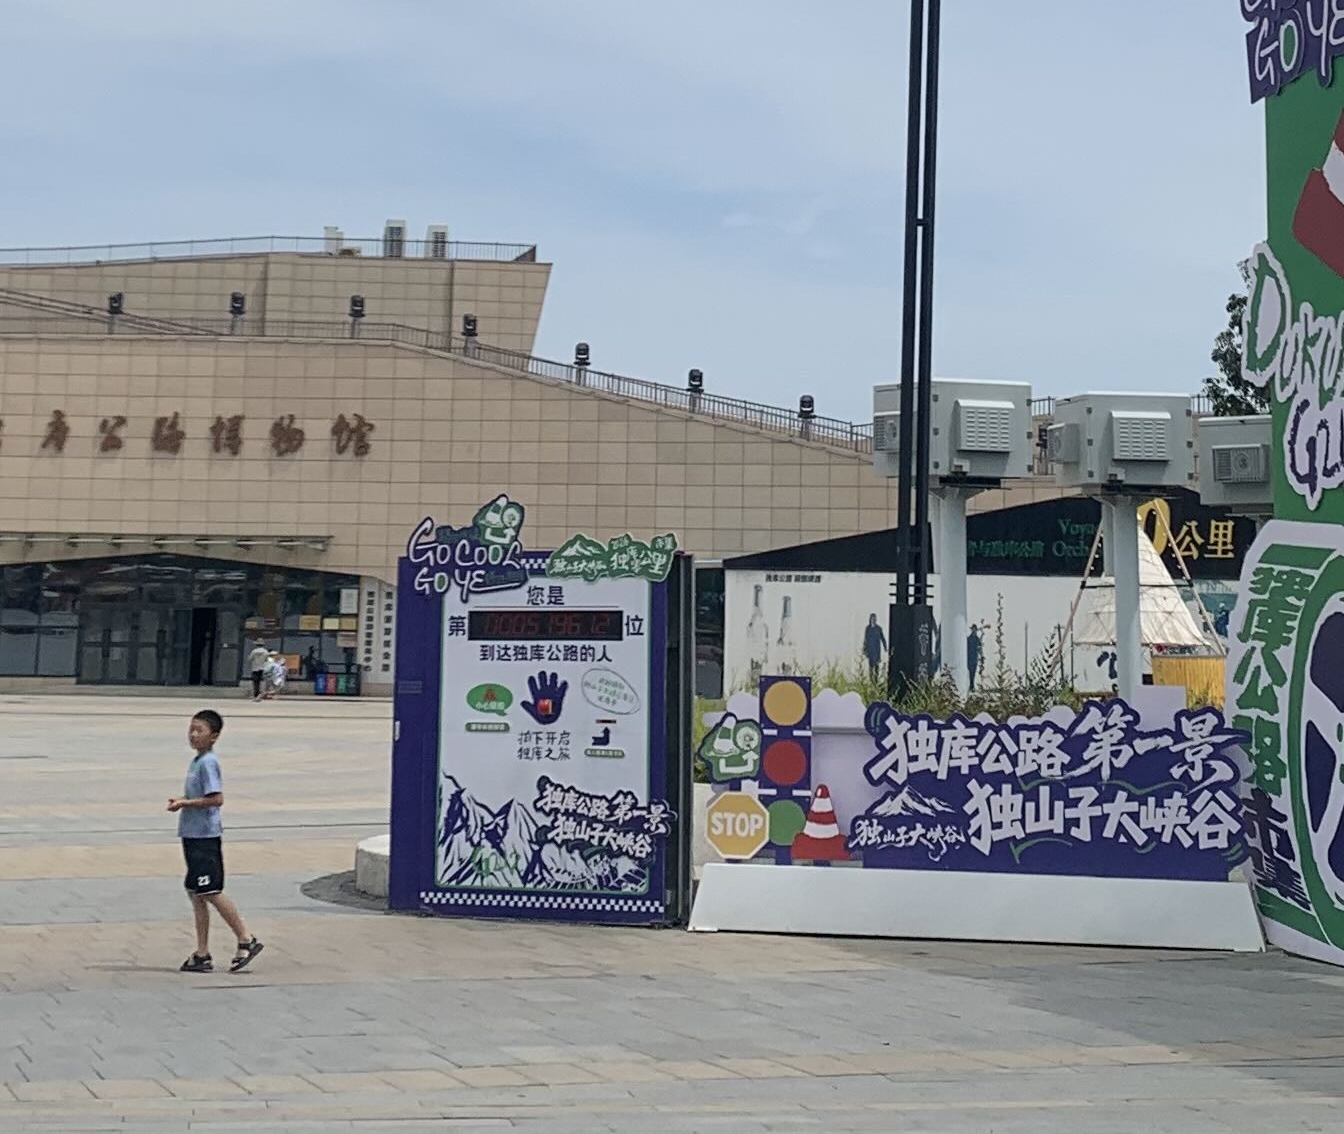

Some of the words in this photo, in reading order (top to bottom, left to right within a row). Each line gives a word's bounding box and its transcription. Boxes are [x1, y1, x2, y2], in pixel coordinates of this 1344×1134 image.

[526, 585, 565, 606] 您是
[448, 616, 467, 637] 第
[625, 615, 644, 637] 位
[480, 643, 613, 663] 到达独库公路的人
[870, 704, 1244, 792] 独库公路第一景
[711, 811, 763, 837] STOP
[962, 778, 1241, 856] 独山子大峡谷
[547, 814, 653, 860] 独山子大峡谷
